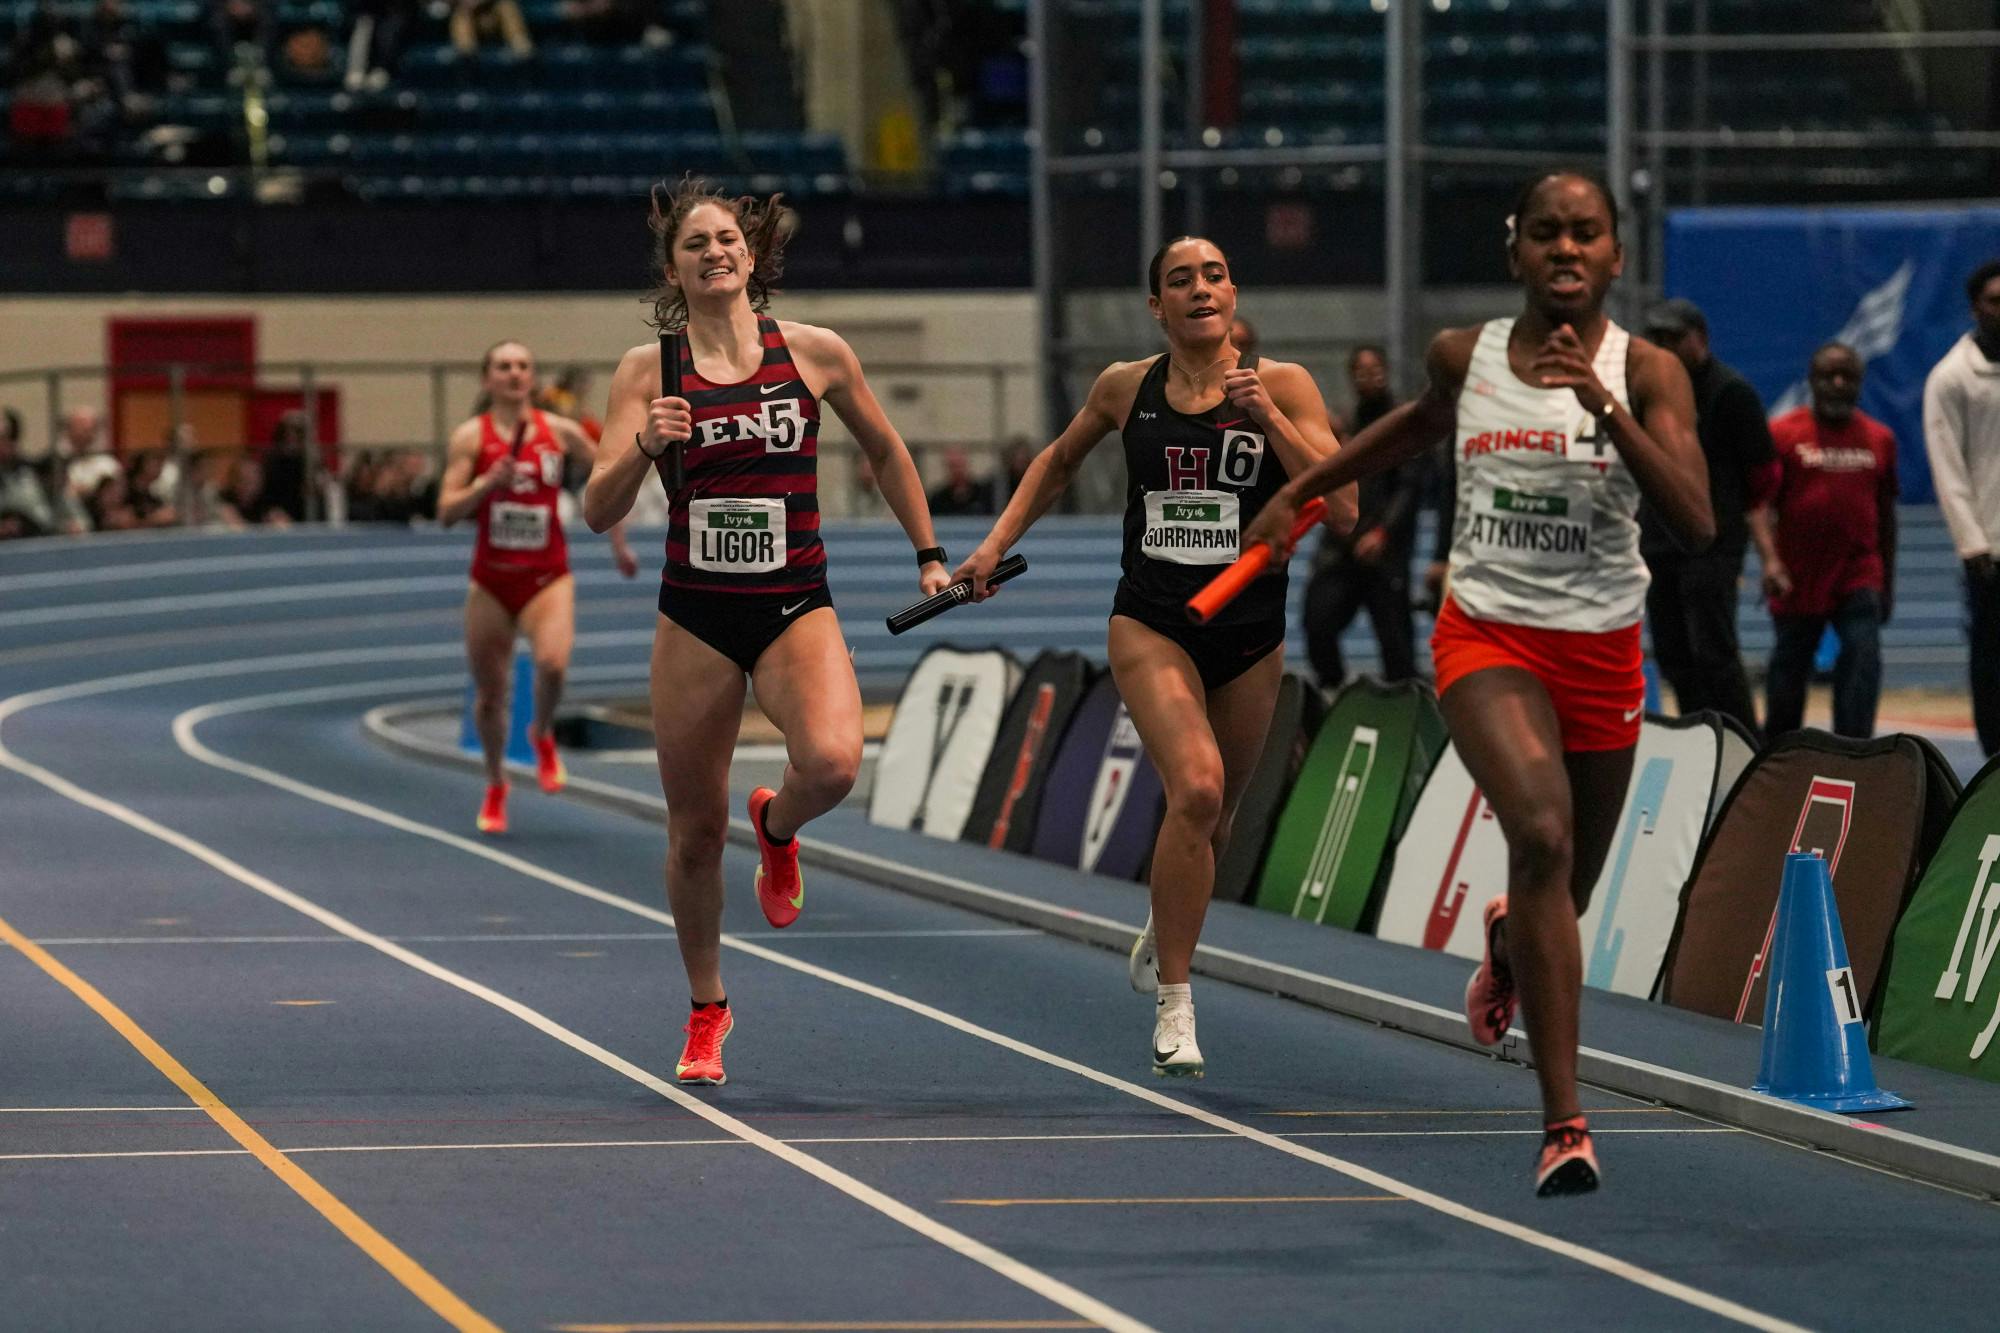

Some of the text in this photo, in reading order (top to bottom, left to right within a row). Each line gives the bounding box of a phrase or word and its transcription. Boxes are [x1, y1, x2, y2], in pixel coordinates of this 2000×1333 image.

[767, 402, 796, 449] 5
[1574, 410, 1613, 456] 4
[1165, 446, 1210, 490] H
[1225, 434, 1257, 482] 6
[723, 513, 743, 527] Ivy
[1175, 505, 1196, 519] Ivy
[1470, 512, 1588, 552] ATKINSON
[701, 530, 775, 563] LIGOR
[1144, 527, 1237, 549] GORRIARAN
[1834, 970, 1857, 1019] 1
